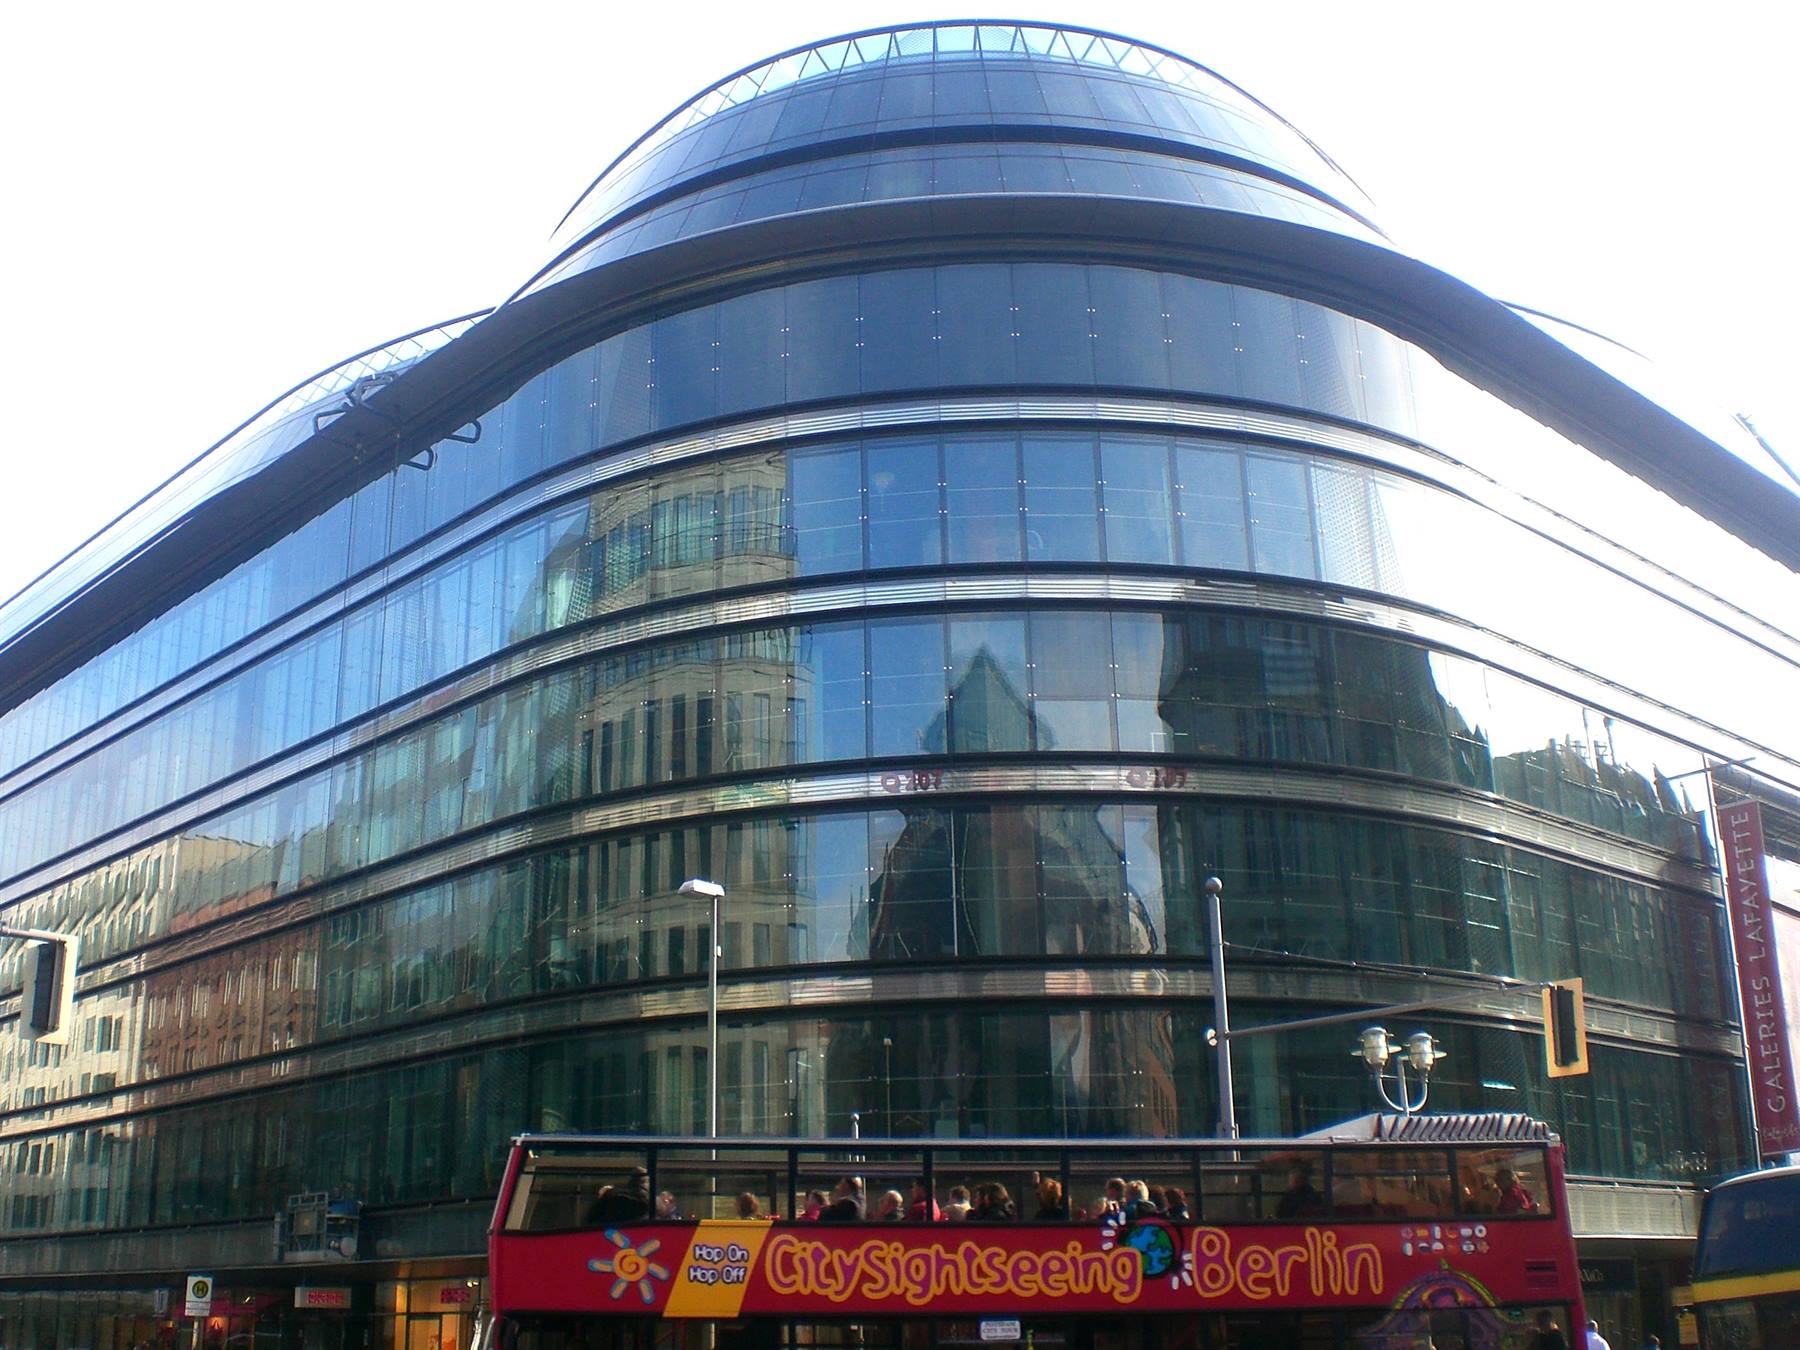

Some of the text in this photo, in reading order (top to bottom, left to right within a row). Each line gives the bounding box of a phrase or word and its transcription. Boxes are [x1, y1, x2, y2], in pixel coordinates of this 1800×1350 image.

[1731, 811, 1766, 963] LAFAYETTE
[1752, 975, 1786, 1113] GALERIES
[688, 1265, 746, 1285] Hop Off
[694, 1244, 748, 1264] Hop On
[1192, 1227, 1383, 1299] Berlin
